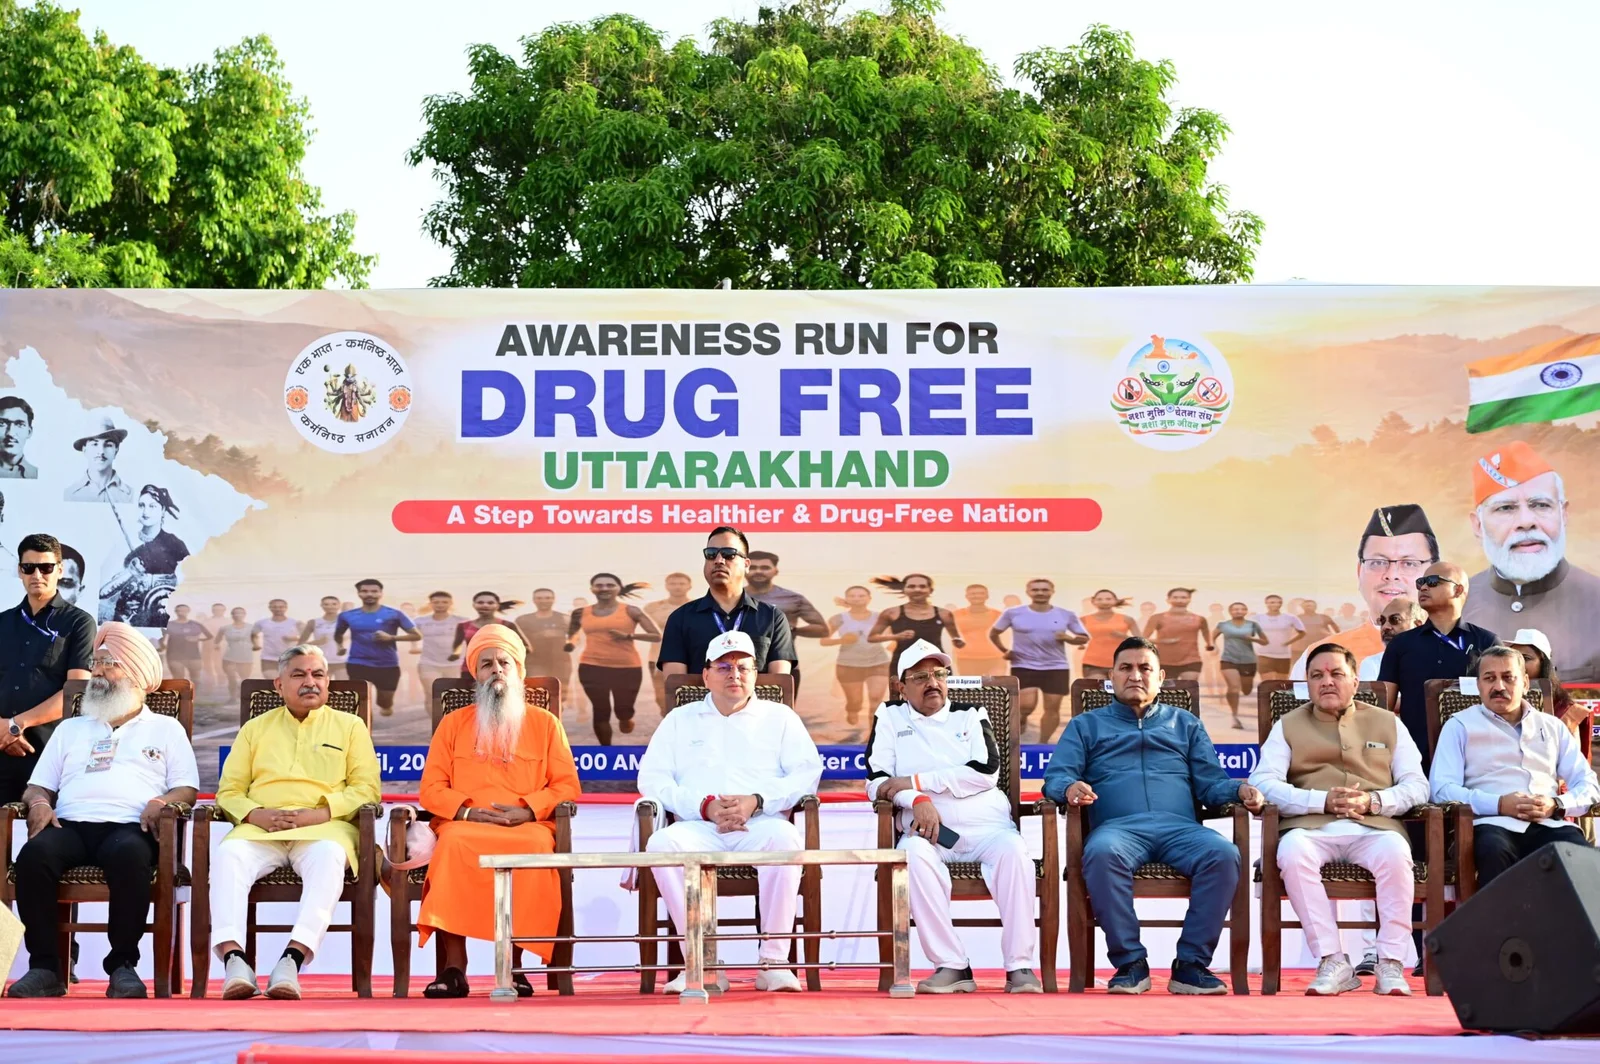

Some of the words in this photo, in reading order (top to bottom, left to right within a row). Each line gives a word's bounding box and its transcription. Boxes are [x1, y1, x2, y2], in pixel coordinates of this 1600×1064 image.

[496, 323, 781, 357] AWARENESS
[795, 323, 888, 355] RUN
[906, 322, 999, 354] FOR
[295, 357, 312, 375] एक
[311, 342, 333, 360] भारत
[385, 354, 404, 376] भारत
[461, 368, 739, 439] DRUG
[780, 368, 1034, 437] FREE
[1128, 412, 1145, 421] नशा
[1147, 407, 1166, 420] मुक्ति
[354, 416, 396, 443] सनातन
[1141, 420, 1158, 430] नशा
[544, 451, 949, 490] UTTARAKHAND
[447, 506, 466, 524] A
[474, 505, 534, 529] Step
[543, 505, 653, 525] Towards
[662, 504, 785, 524] Healthier
[792, 504, 811, 523] &
[820, 504, 954, 528] Drug-Free
[963, 503, 1048, 523] Nation
[376, 752, 394, 774] il,
[399, 753, 425, 771] 20
[574, 753, 608, 771] :00
